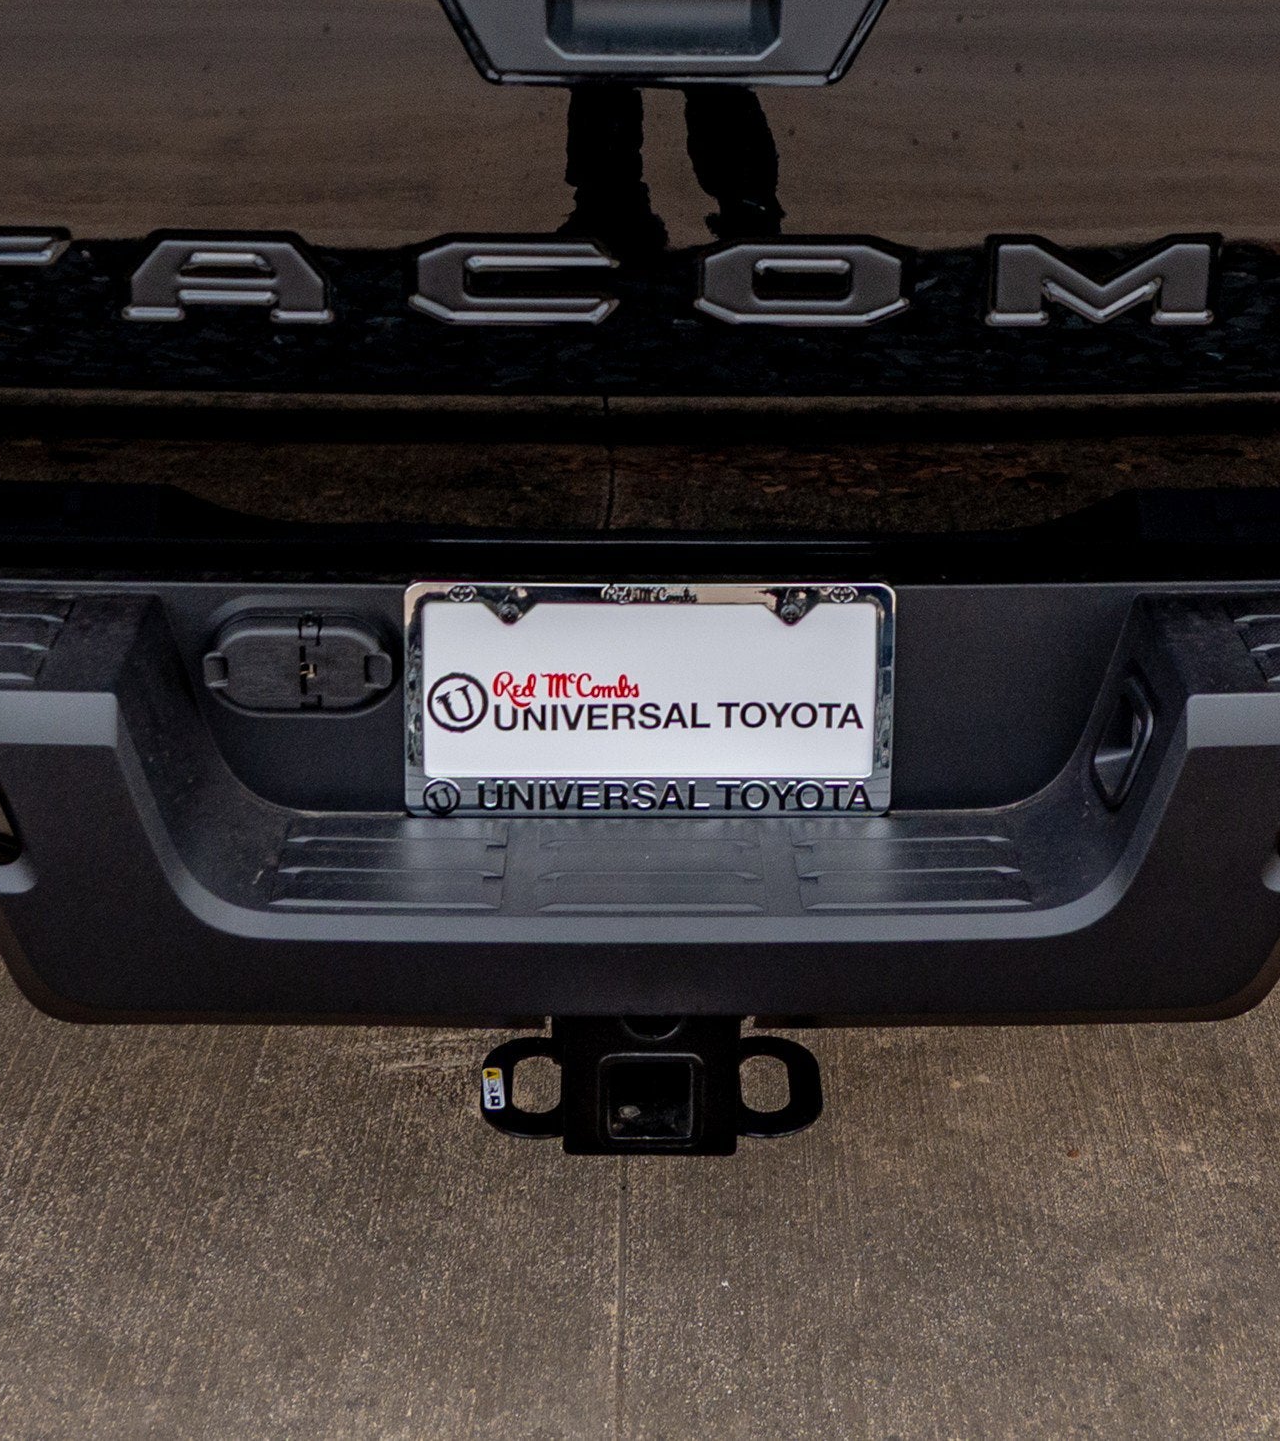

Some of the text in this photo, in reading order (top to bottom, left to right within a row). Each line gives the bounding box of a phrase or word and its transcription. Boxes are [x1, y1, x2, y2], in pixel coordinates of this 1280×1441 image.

[492, 671, 640, 704] Red McCombs
[493, 702, 864, 731] UNIVERSAL TOYOTA
[477, 780, 710, 811] UNIVERSAL
[716, 780, 874, 811] TOYOTA
